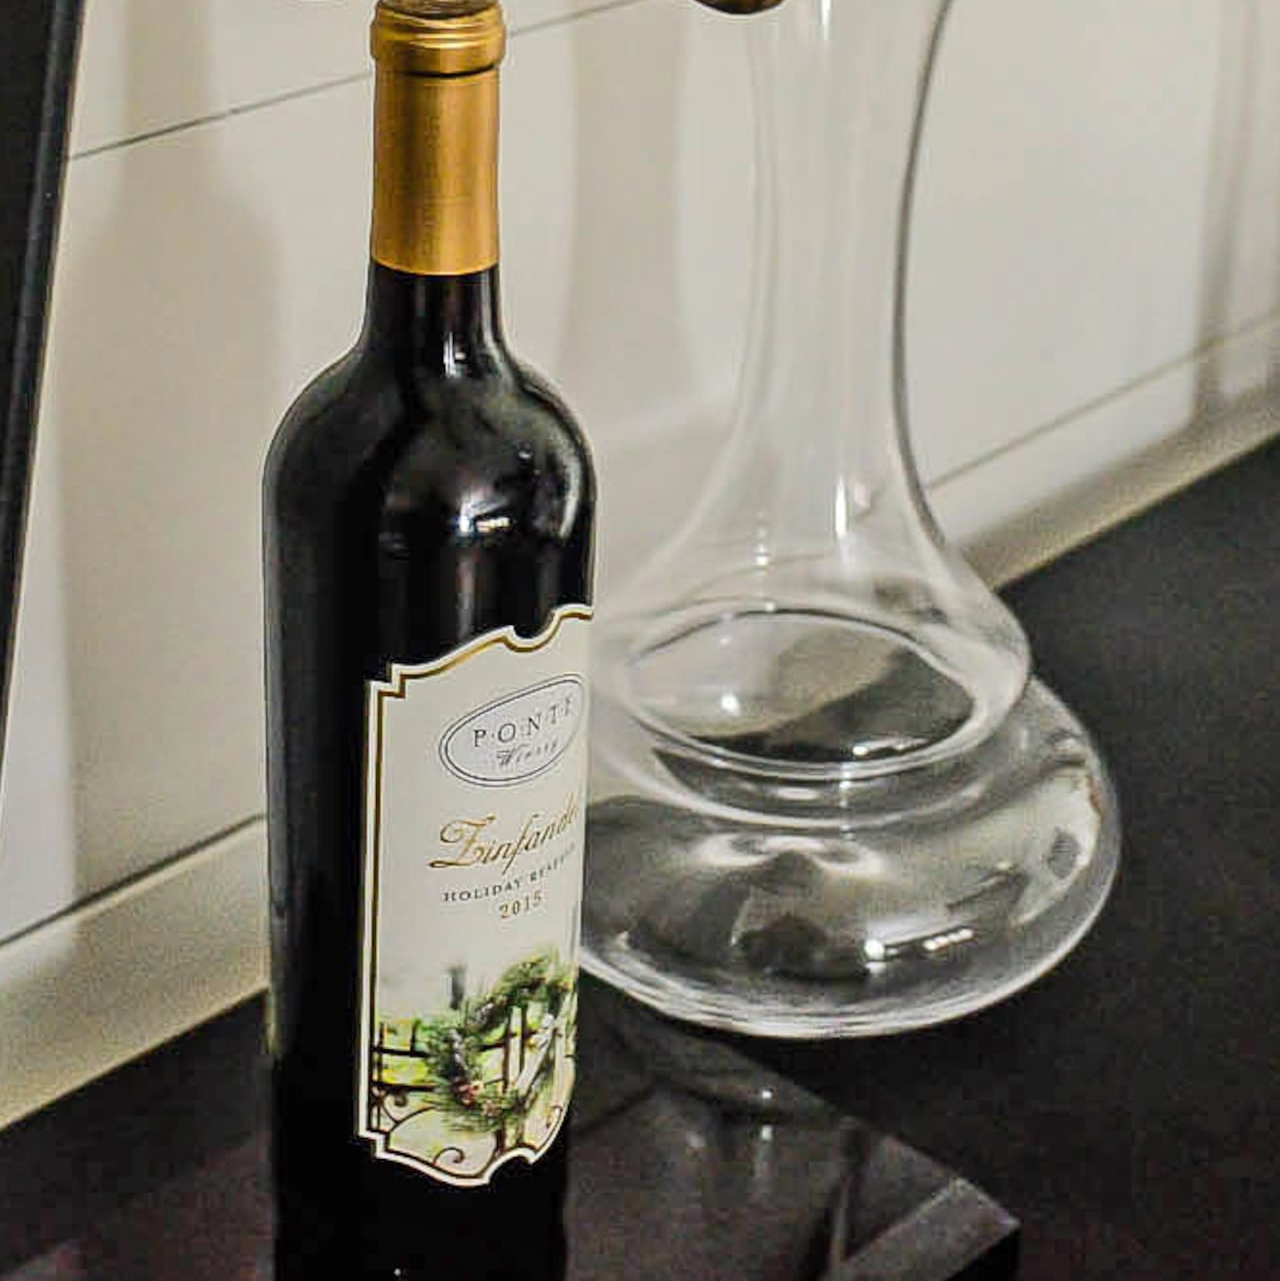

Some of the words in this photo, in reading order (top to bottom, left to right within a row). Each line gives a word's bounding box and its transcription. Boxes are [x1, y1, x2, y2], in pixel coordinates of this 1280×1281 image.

[428, 790, 580, 876] Zinfande
[442, 876, 523, 903] HOLIDAY
[498, 889, 543, 920] 2015
